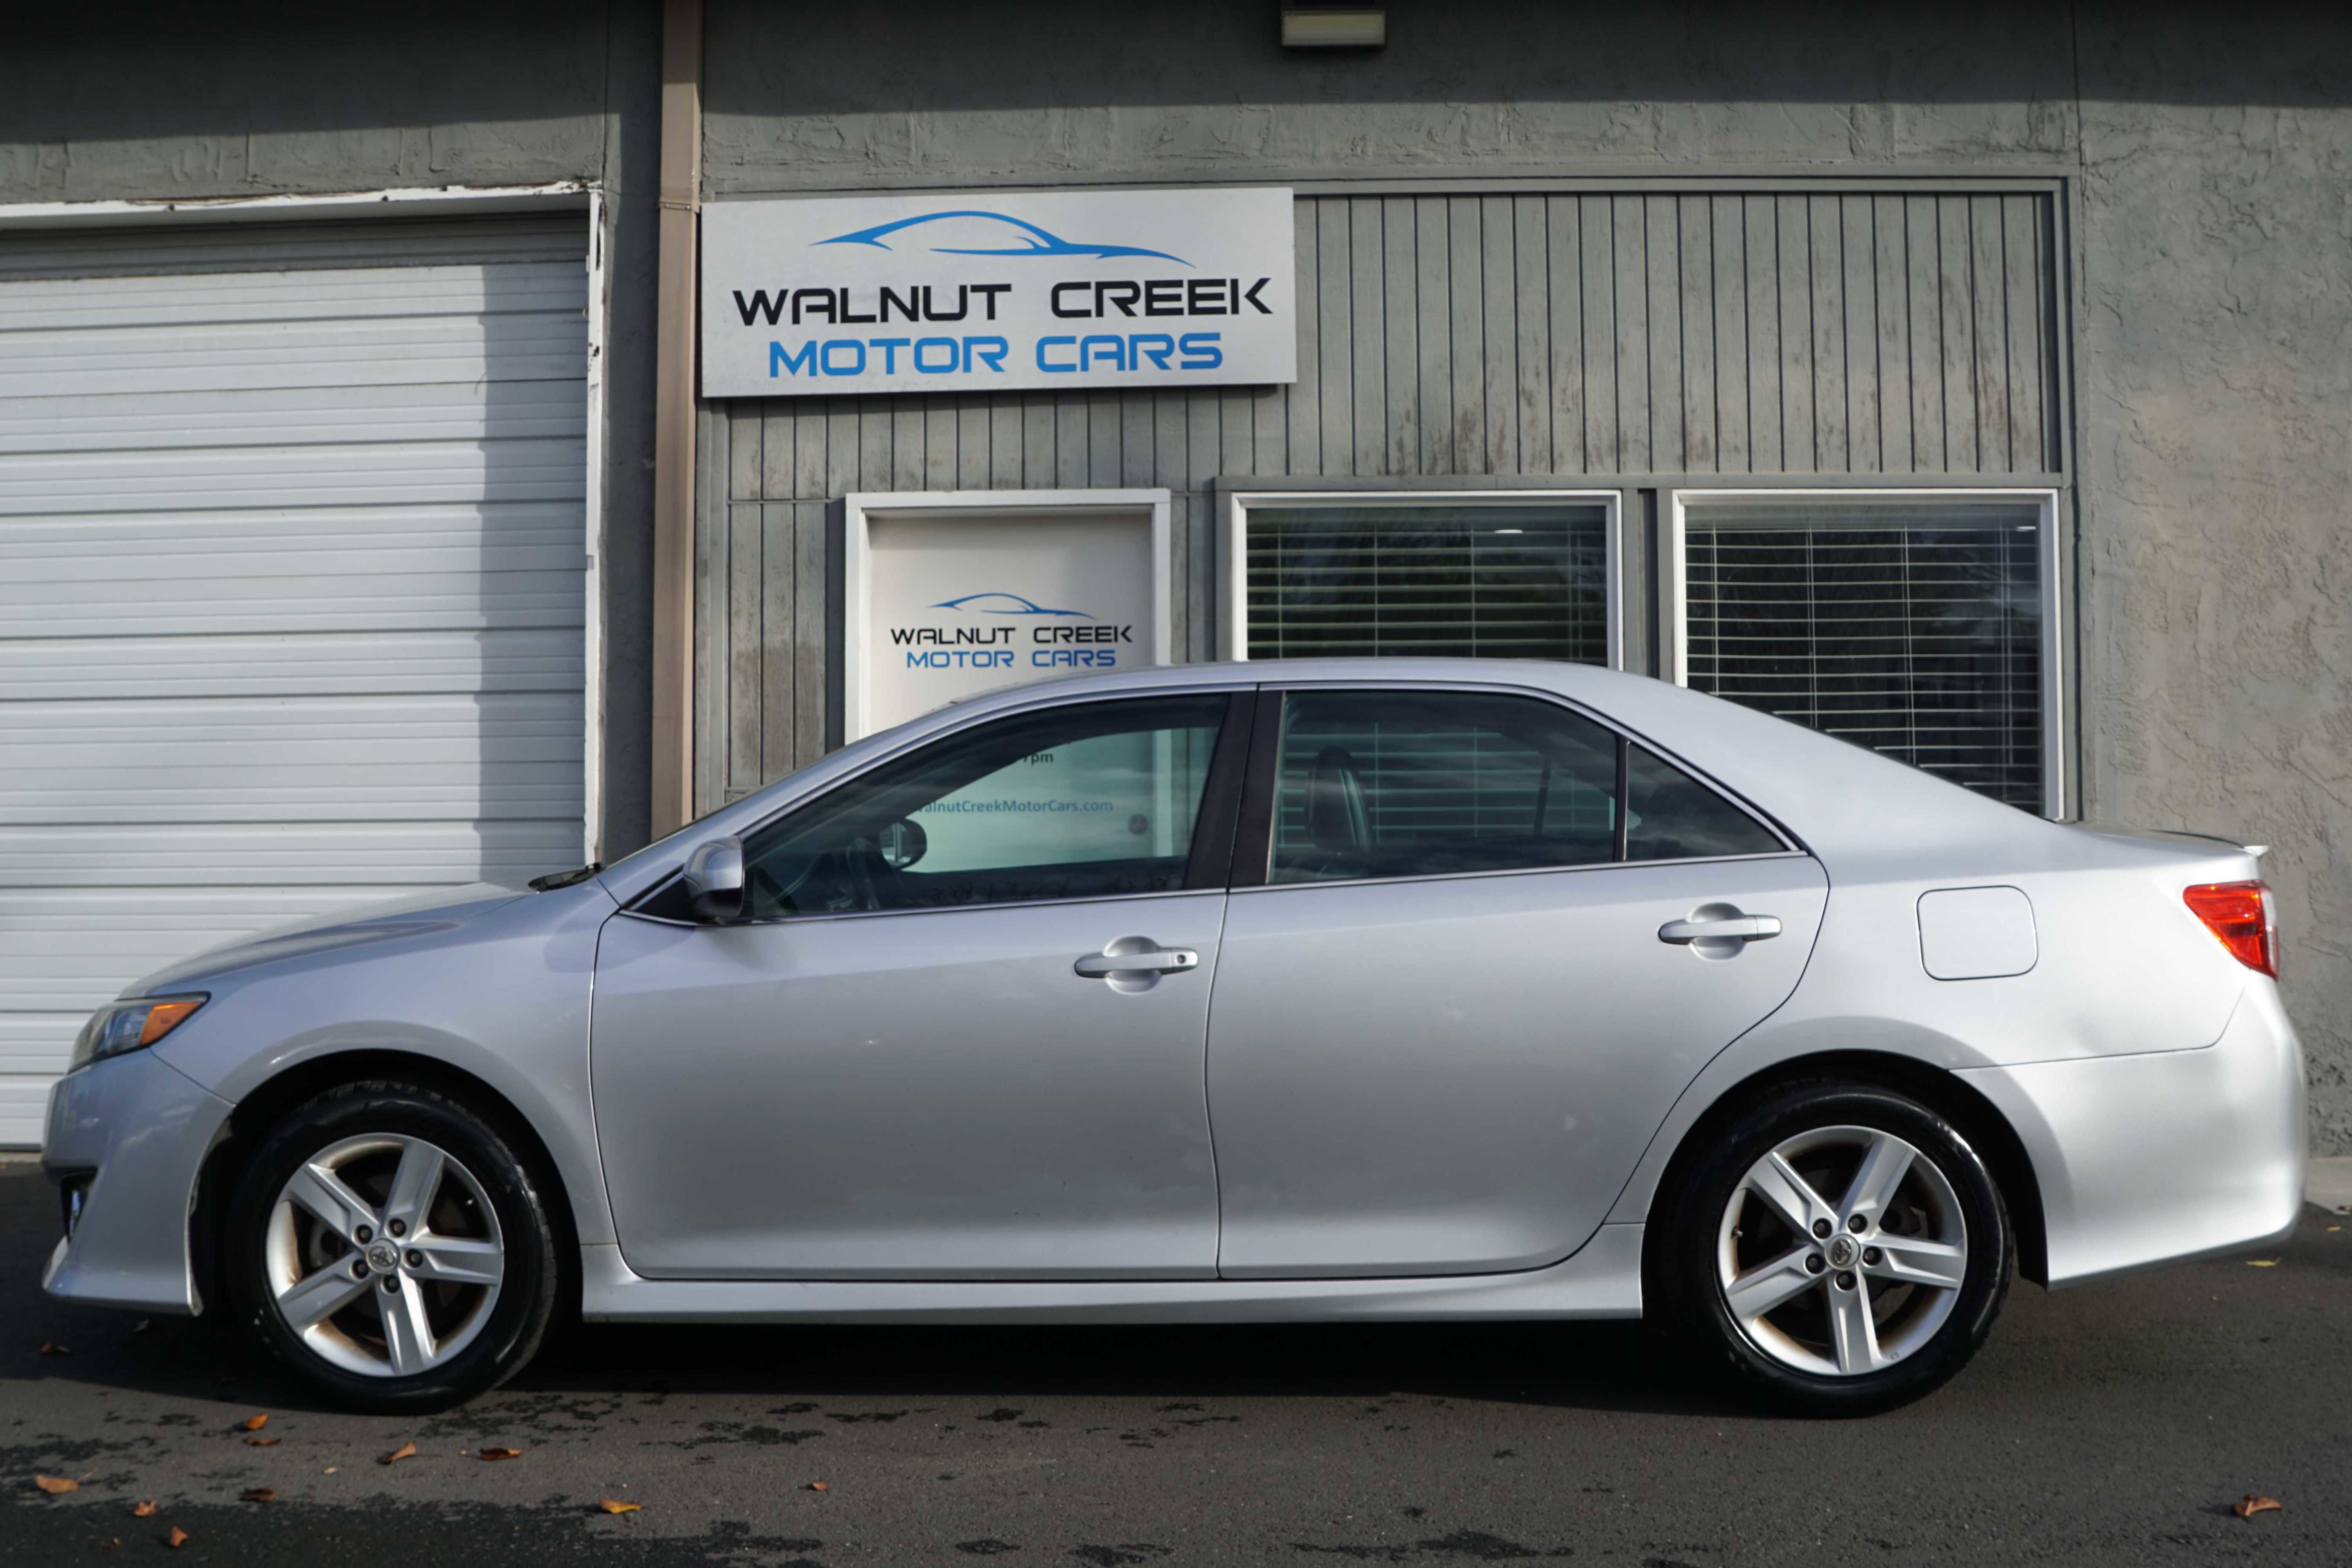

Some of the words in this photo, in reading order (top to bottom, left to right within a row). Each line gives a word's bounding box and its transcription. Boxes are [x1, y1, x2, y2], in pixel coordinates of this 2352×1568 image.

[733, 283, 1012, 326] WALNUT
[1051, 277, 1273, 318] CREEK
[769, 335, 1009, 378] MOTOR
[1036, 332, 1223, 373] CARS
[891, 627, 1016, 645] WALNUT
[1033, 625, 1133, 644] CREEK
[906, 650, 1015, 668] MOTOR
[1031, 650, 1116, 667] CARS
[918, 799, 1114, 813] alnutCreekMotorCars.com
